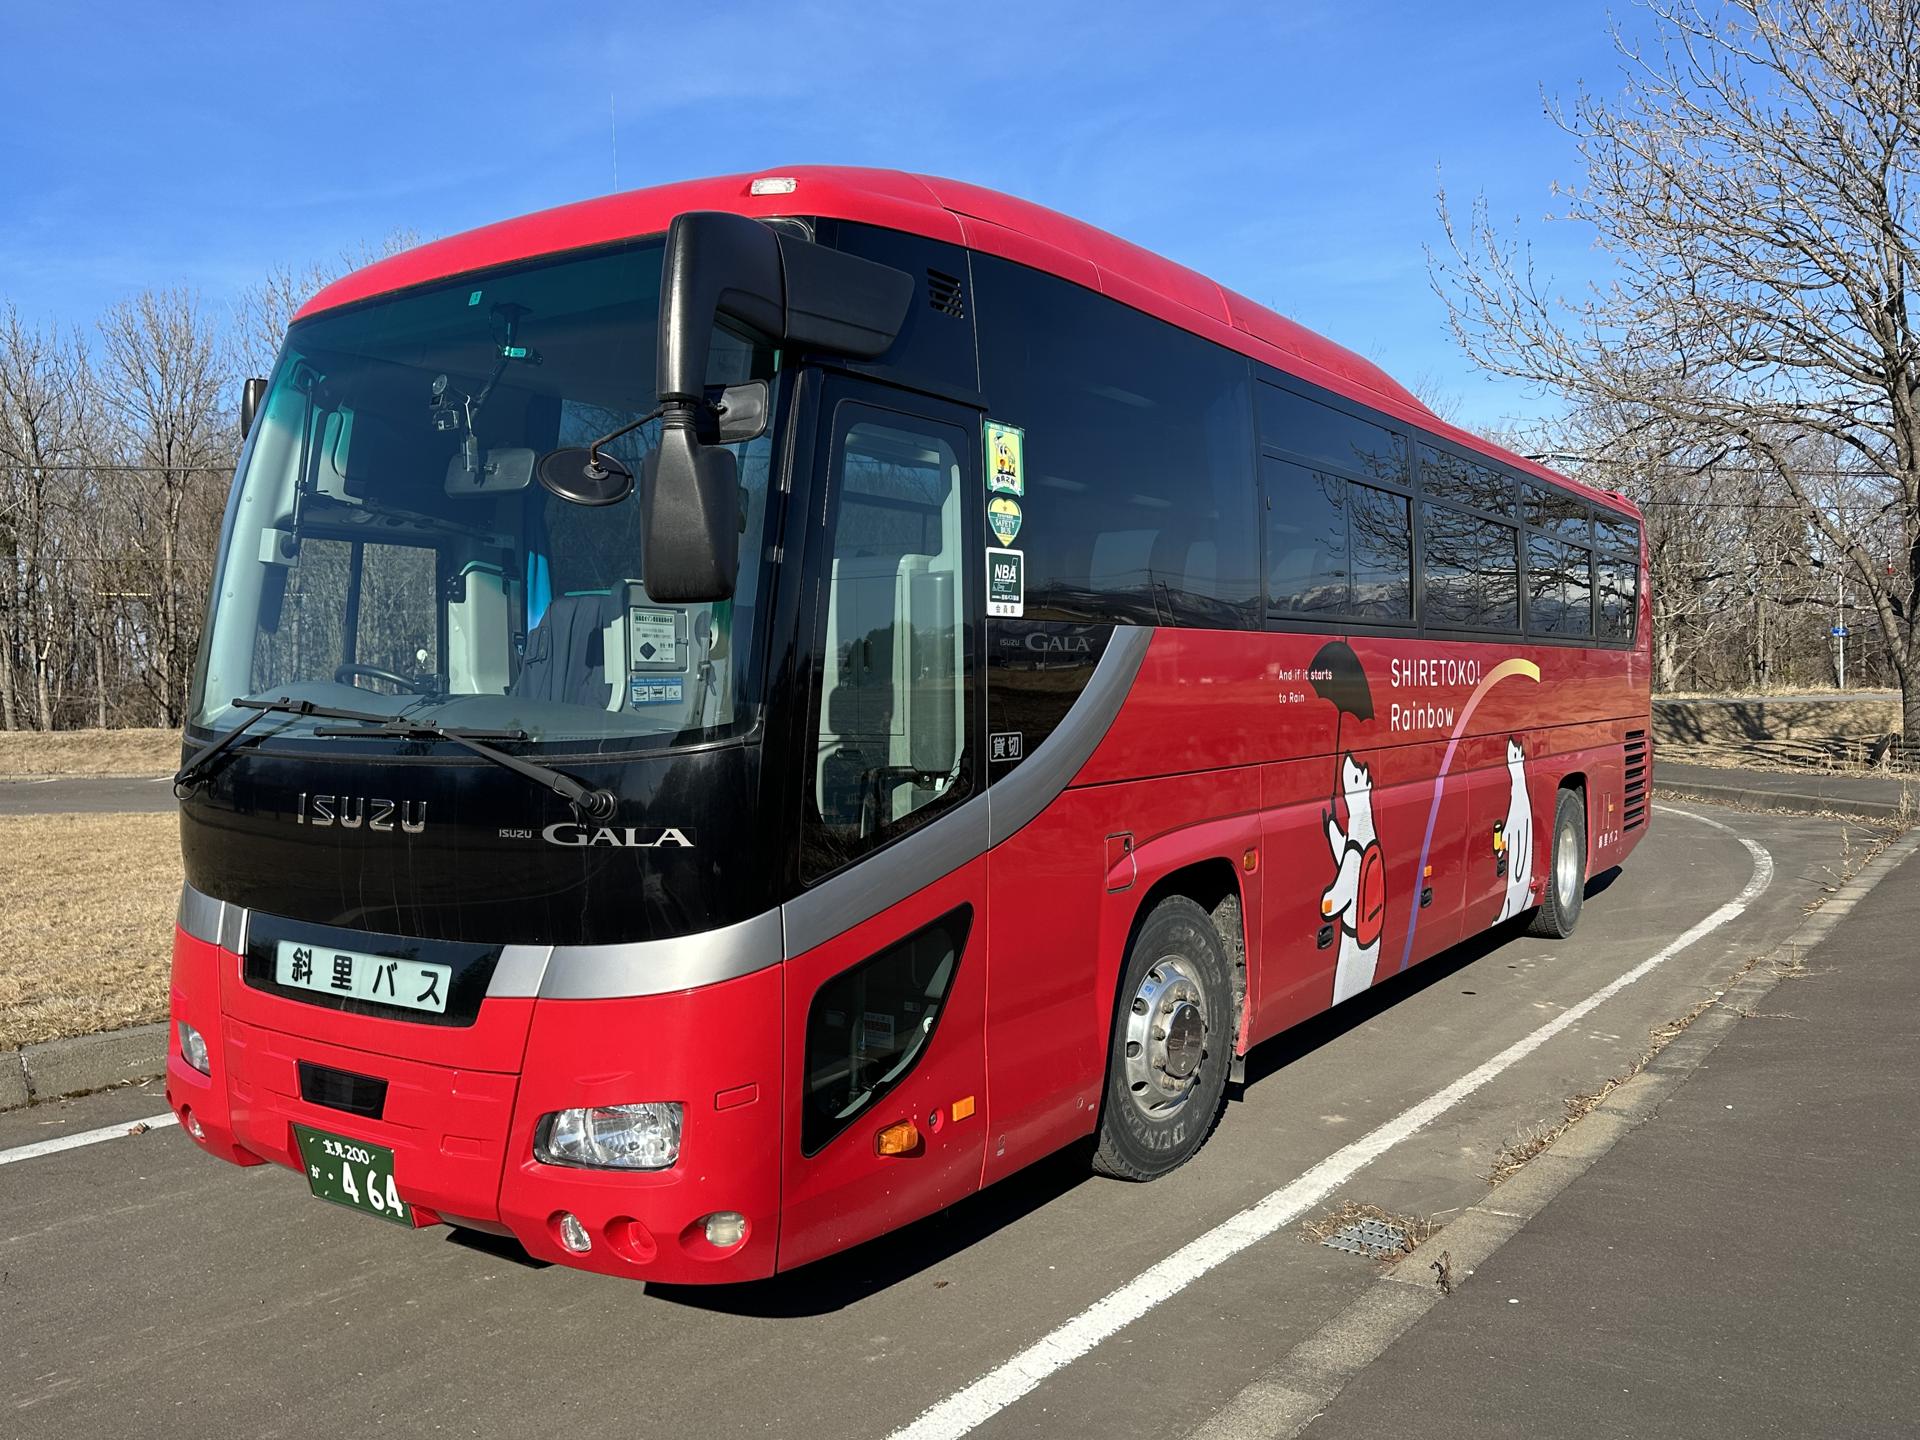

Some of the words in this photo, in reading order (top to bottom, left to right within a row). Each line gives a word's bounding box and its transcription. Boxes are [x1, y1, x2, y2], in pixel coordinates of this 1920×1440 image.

[995, 518, 1015, 528] SAFETY
[1000, 526, 1012, 535] BUS
[994, 563, 1017, 581] NBA
[1000, 639, 1020, 647] ISUZU
[1024, 632, 1091, 652] GALA
[1279, 668, 1293, 681] And
[1294, 668, 1301, 680] if
[1302, 668, 1309, 681] it
[1310, 668, 1333, 681] starts
[1391, 658, 1481, 688] SHIRETOKO!
[1278, 692, 1287, 704] to
[1289, 690, 1305, 703] Rain
[1391, 701, 1454, 732] Rainbow
[993, 736, 1019, 758] 貸切
[297, 792, 427, 834] ISUZU
[498, 828, 533, 840] ISUZU
[542, 821, 695, 848] GALA
[291, 947, 441, 1006] 斜里バス
